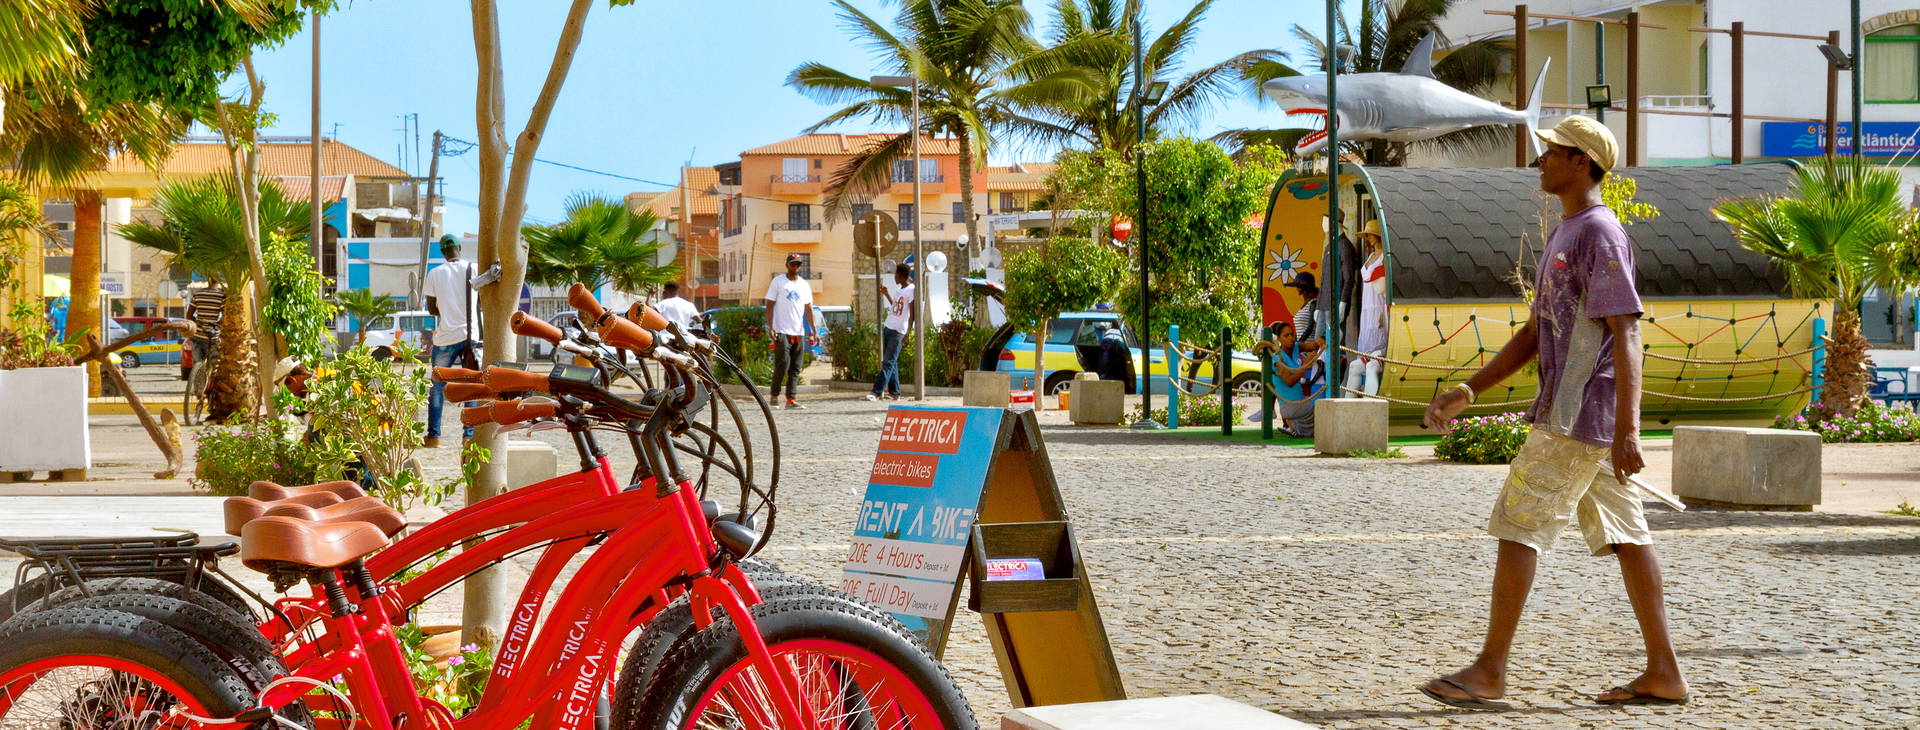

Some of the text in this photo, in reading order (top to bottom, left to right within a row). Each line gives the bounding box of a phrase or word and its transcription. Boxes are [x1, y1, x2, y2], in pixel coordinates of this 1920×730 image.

[1818, 125, 1847, 135] Baco
[1818, 133, 1915, 147] Iertlântico
[881, 417, 958, 444] ELECTRICA
[873, 459, 932, 478] electric bikes
[857, 500, 974, 540] RENT A BIKE
[848, 542, 872, 564] 20€
[876, 545, 886, 564] 4
[886, 546, 925, 570] Hours
[923, 561, 939, 571] Deposit
[864, 582, 889, 605] Full
[888, 585, 915, 612] Day
[911, 600, 928, 609] Deposit
[497, 602, 538, 679] ELECTRICA
[556, 620, 589, 670] TRICA
[559, 655, 602, 730] LECTRICA
